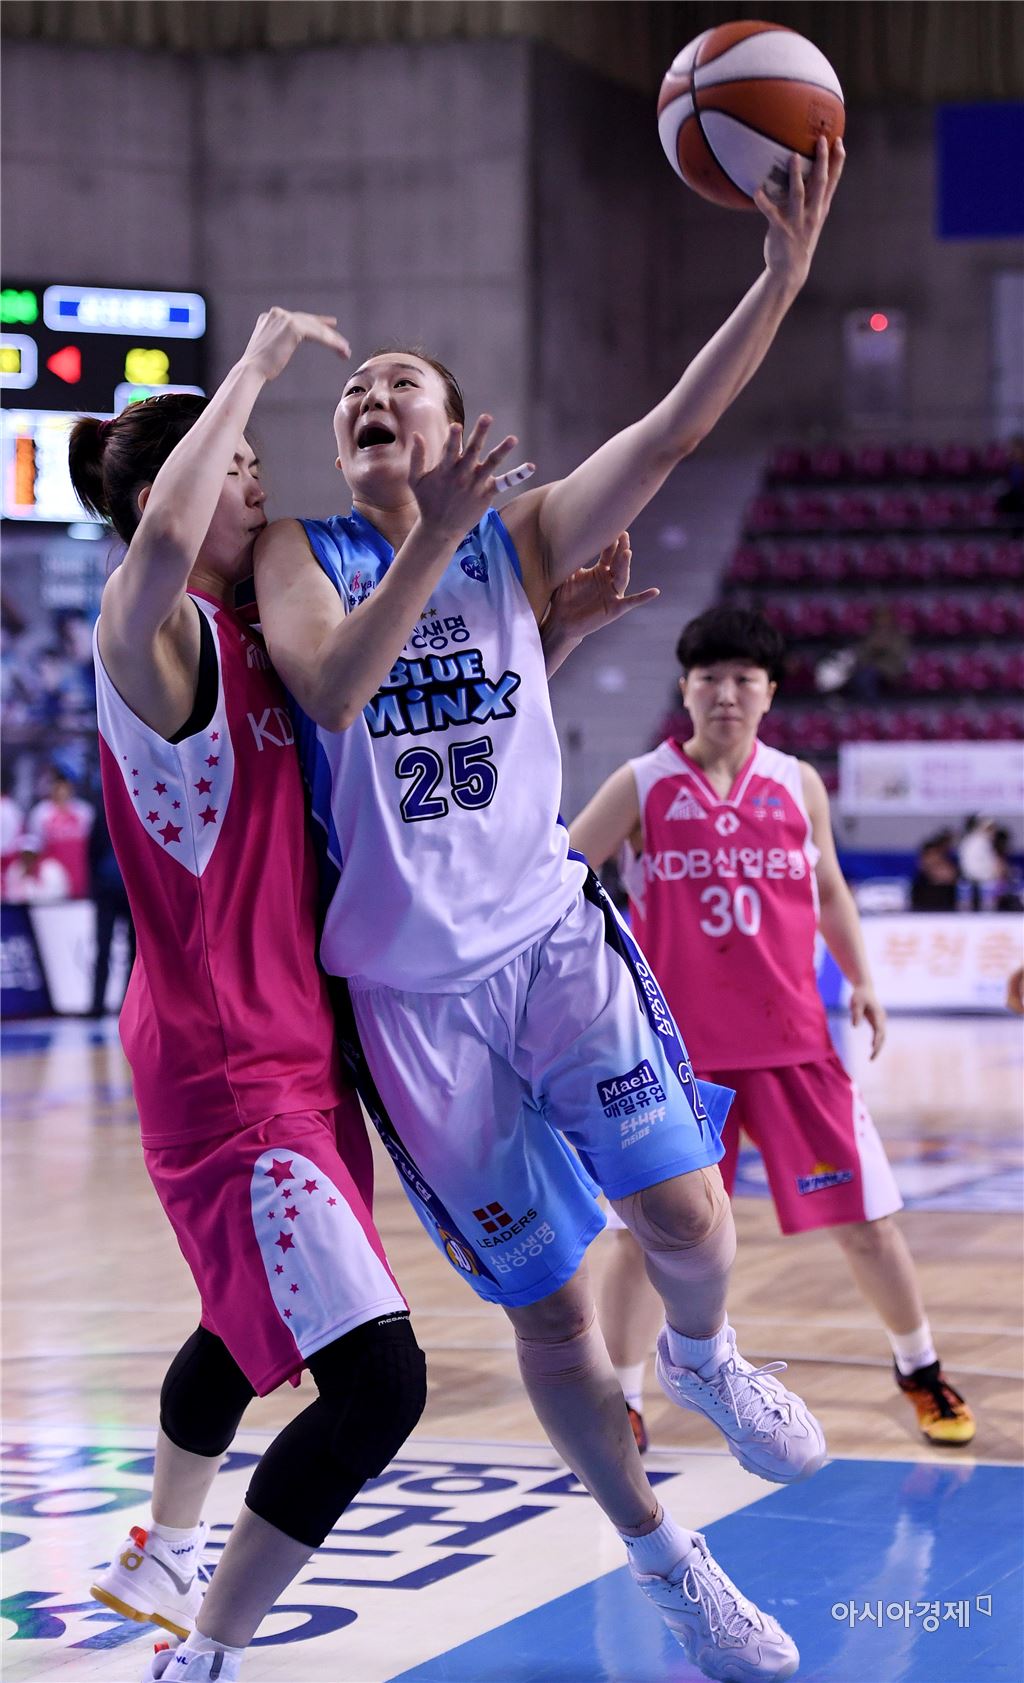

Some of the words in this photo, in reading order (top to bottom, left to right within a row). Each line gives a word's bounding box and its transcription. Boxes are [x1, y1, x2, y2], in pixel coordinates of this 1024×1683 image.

[411, 614, 470, 650] 생명
[378, 649, 485, 693] BLUE
[395, 736, 498, 823] 25
[700, 885, 761, 937] 30
[602, 1066, 653, 1102] Maeil
[603, 1085, 667, 1119] 매일유업
[476, 1208, 537, 1249] LEADERS
[490, 1221, 555, 1273] 삼성생명
